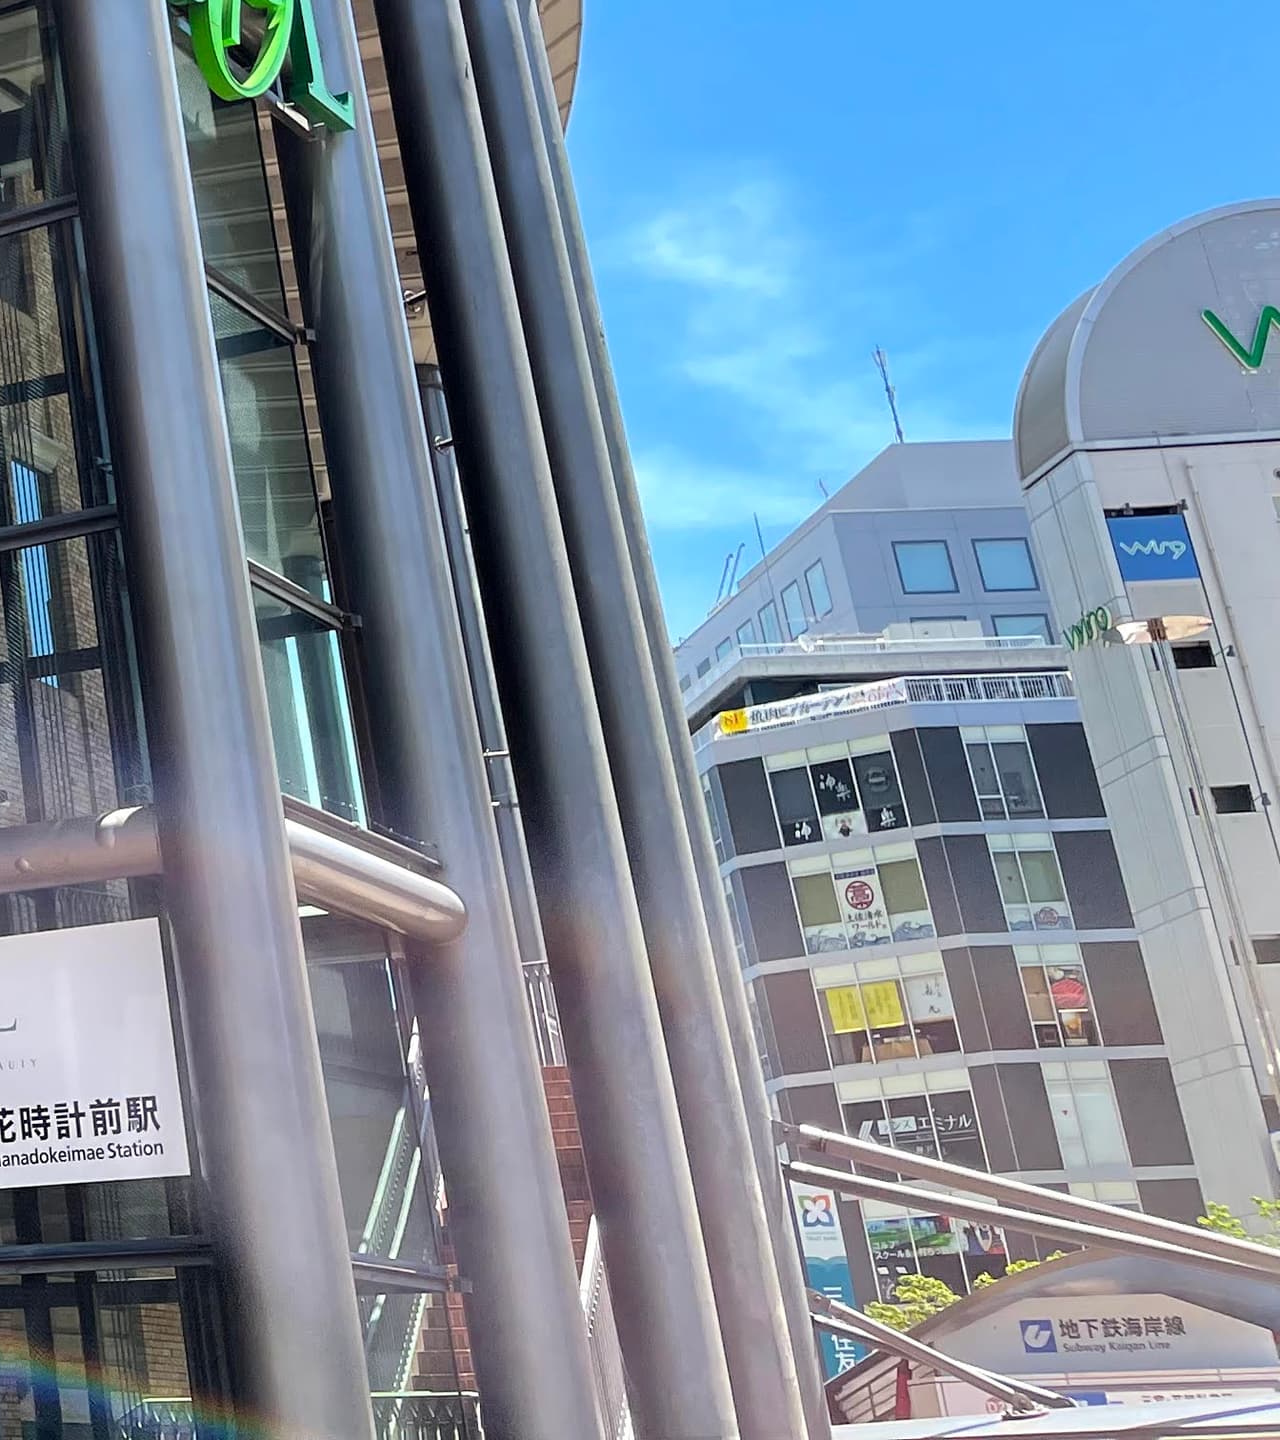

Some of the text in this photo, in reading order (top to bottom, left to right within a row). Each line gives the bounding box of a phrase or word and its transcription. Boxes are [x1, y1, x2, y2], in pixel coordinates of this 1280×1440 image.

[107, 1139, 164, 1160] Station
[1059, 1315, 1187, 1340] 地下鉄海岸線
[1063, 1339, 1171, 1354] Subway Kaigan Line
